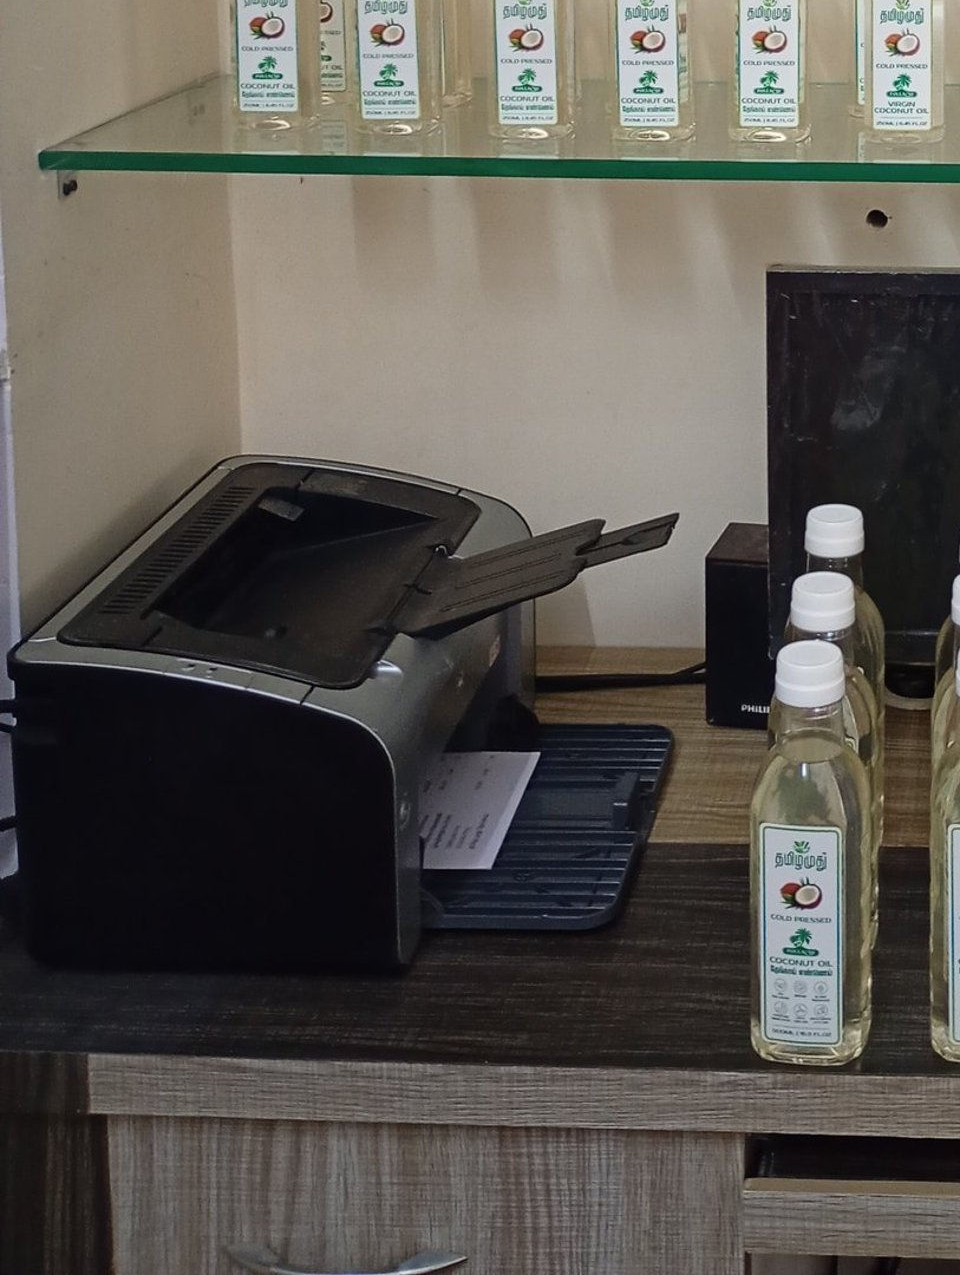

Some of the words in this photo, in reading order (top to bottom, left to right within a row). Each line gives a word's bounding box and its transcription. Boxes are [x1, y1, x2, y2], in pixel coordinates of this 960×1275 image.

[741, 704, 770, 714] PHILI
[770, 913, 792, 922] COLD
[794, 915, 831, 925] PRESSED
[769, 955, 815, 967] COCONUT
[817, 960, 832, 968] OIL
